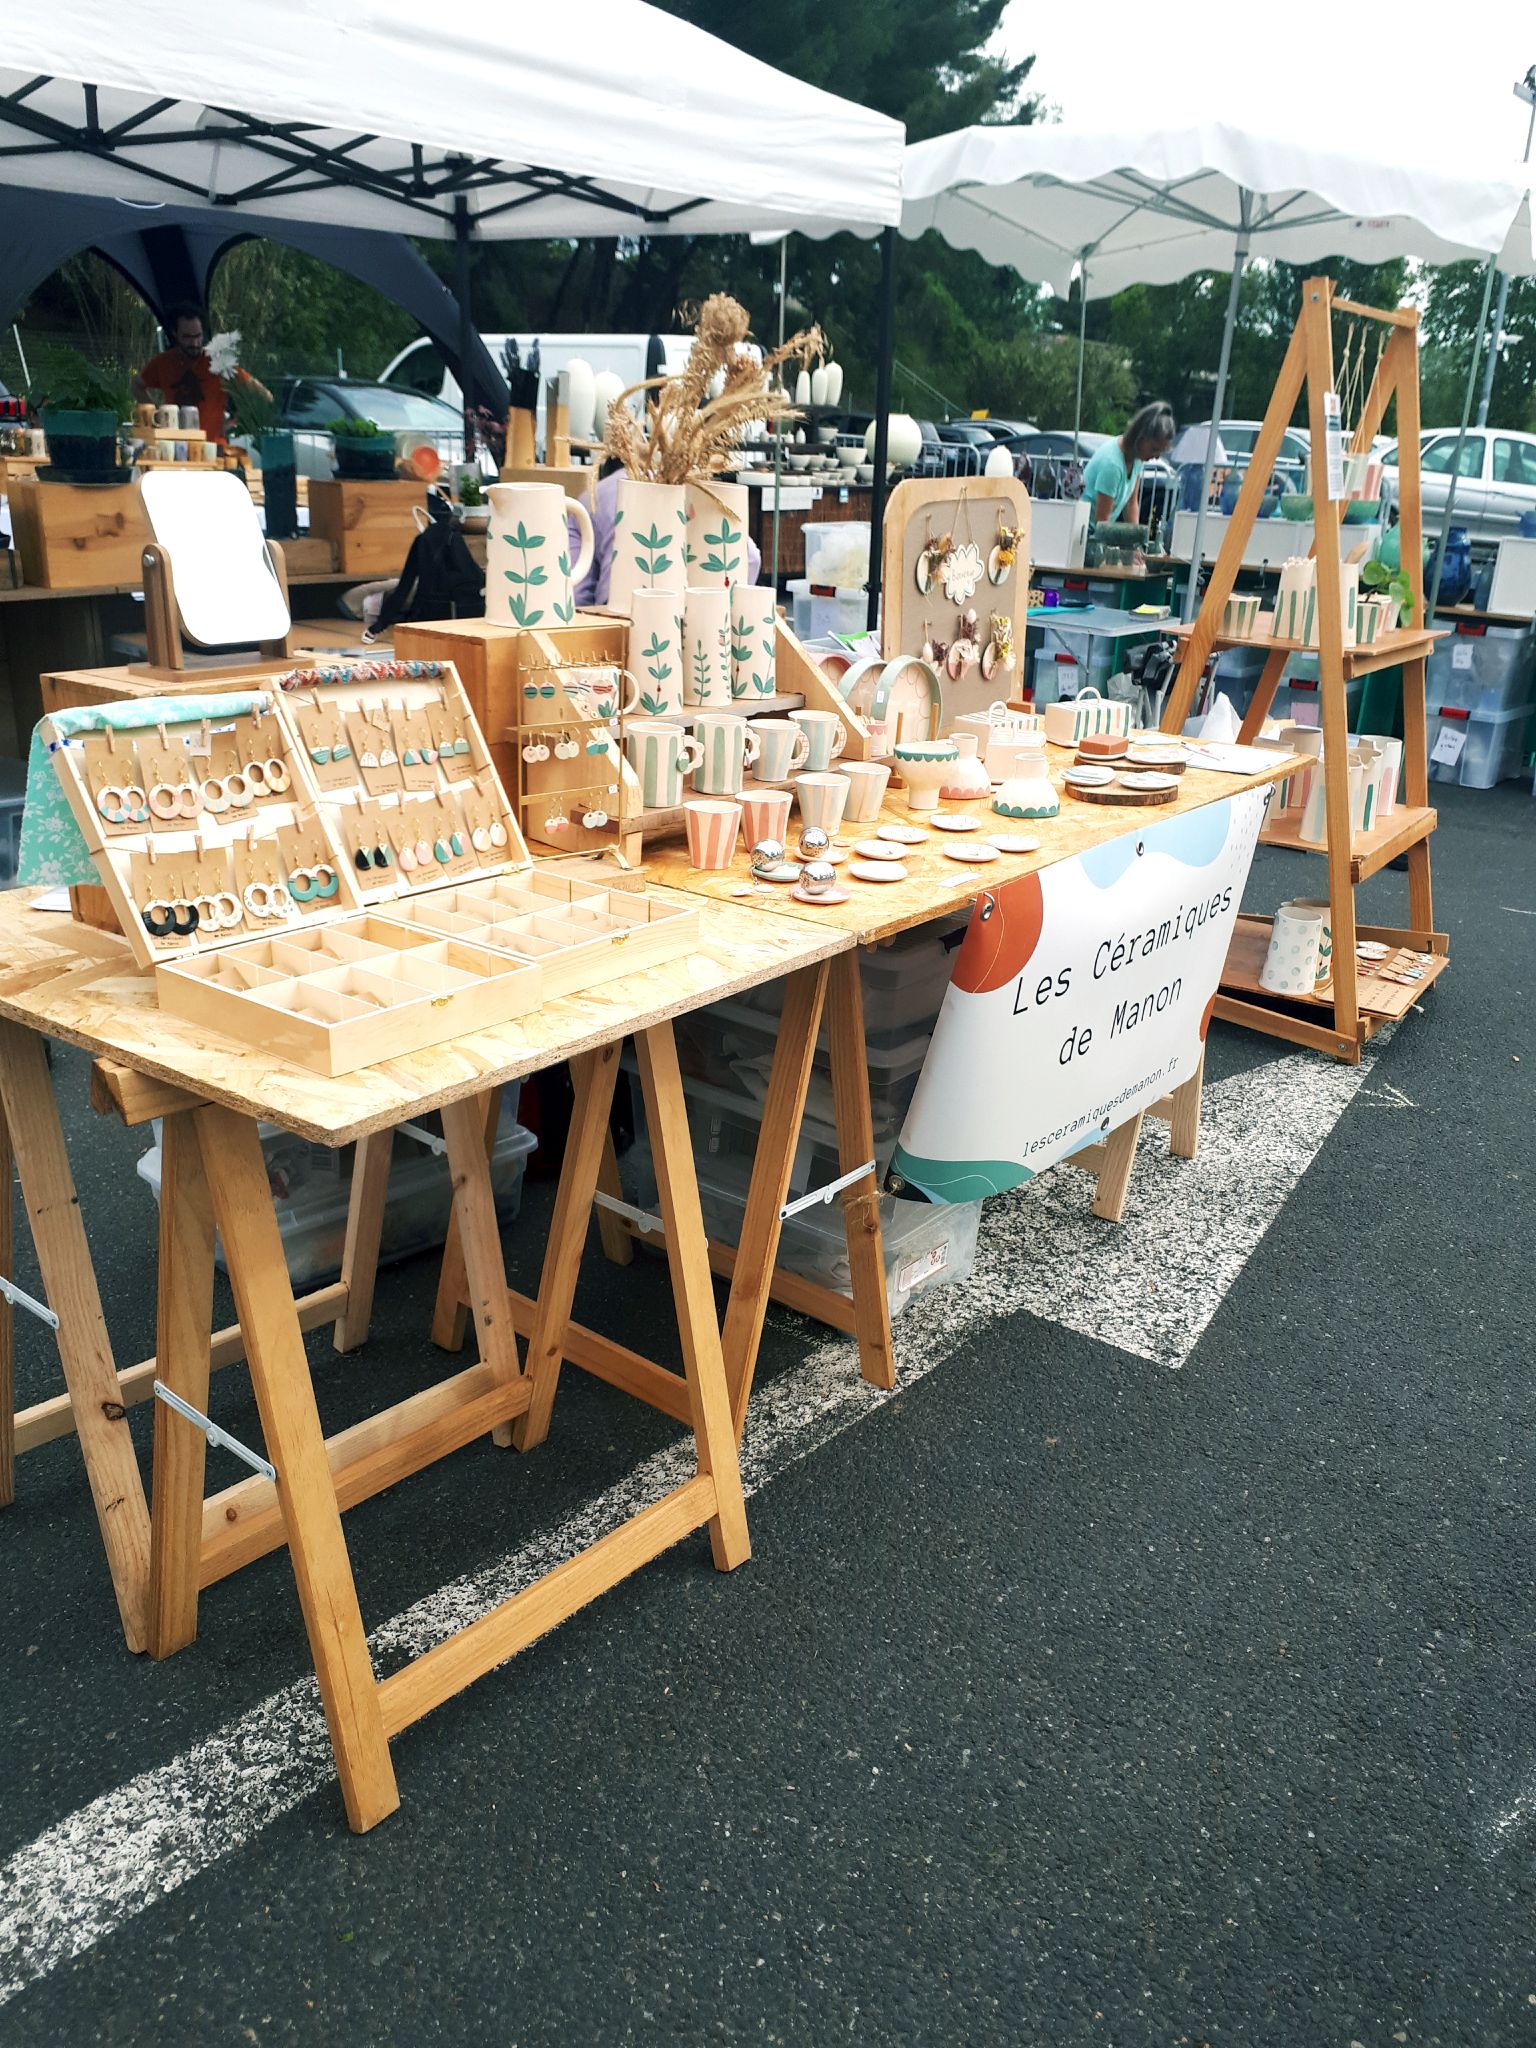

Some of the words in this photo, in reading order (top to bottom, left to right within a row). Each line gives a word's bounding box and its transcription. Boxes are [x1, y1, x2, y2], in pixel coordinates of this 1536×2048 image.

[1013, 966, 1071, 1015] Les
[1093, 885, 1233, 980] Céramiques
[1059, 1025, 1092, 1065] de
[1110, 976, 1183, 1039] Manon
[1022, 1057, 1179, 1157] lesceramiquesdemanon.fr
